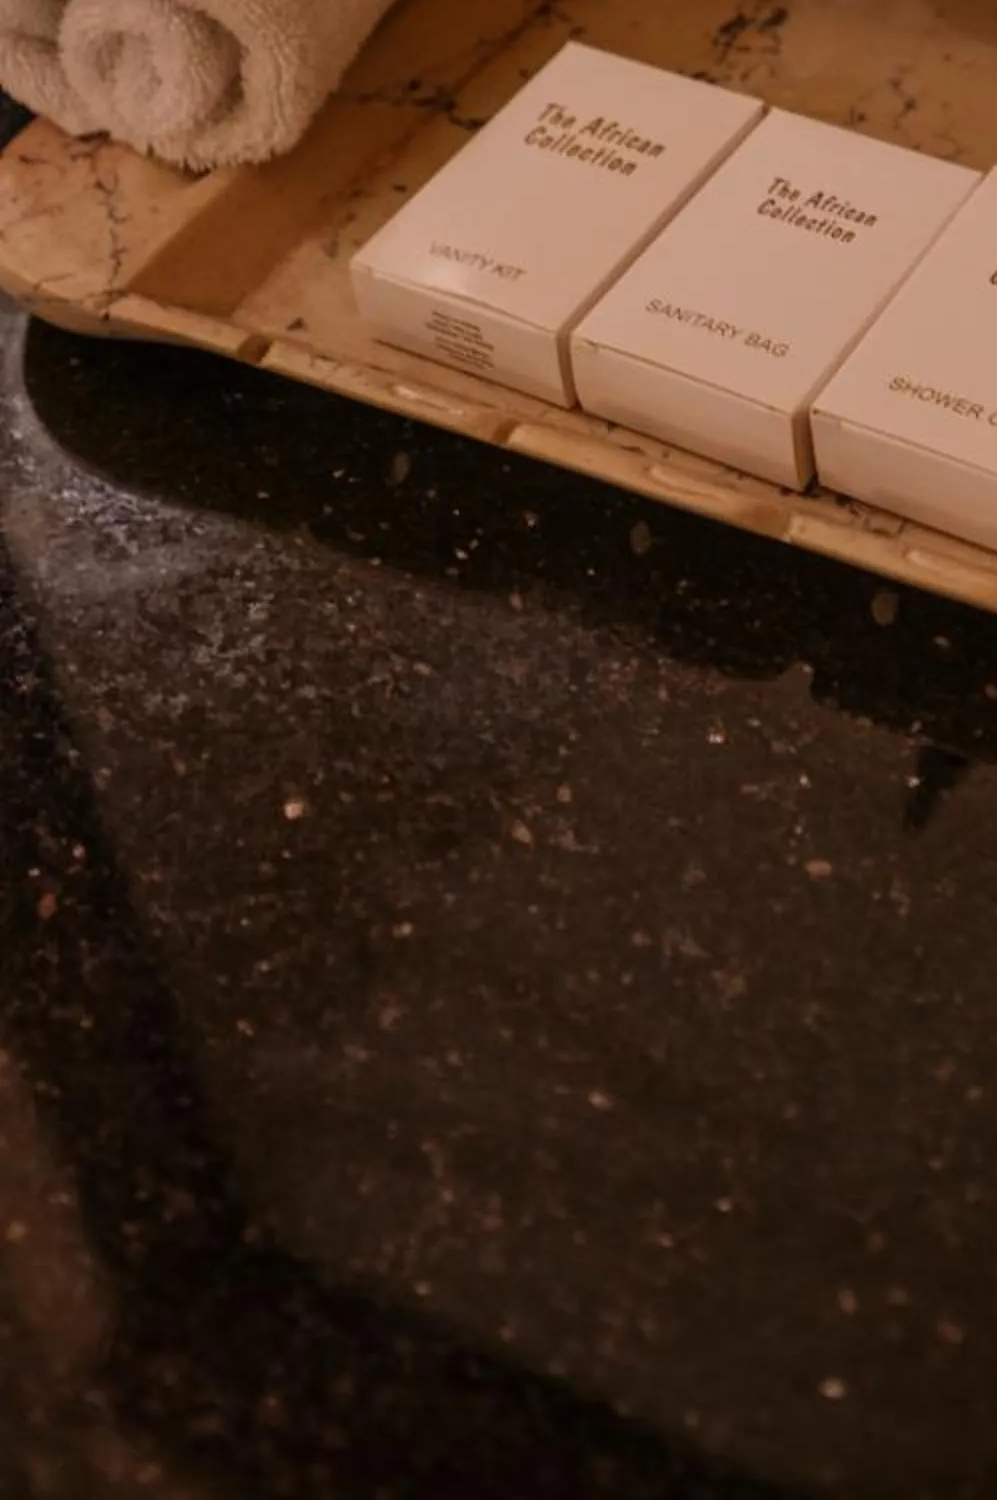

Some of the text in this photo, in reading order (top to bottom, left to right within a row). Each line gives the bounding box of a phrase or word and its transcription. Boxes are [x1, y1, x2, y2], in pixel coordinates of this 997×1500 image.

[524, 125, 638, 176] Collection
[538, 102, 666, 158] The African
[757, 198, 856, 243] Collection
[767, 177, 878, 227] The African
[429, 240, 527, 282] VANITY KIT
[645, 298, 790, 359] SANITARY BAG
[889, 375, 985, 421] SHOWER
